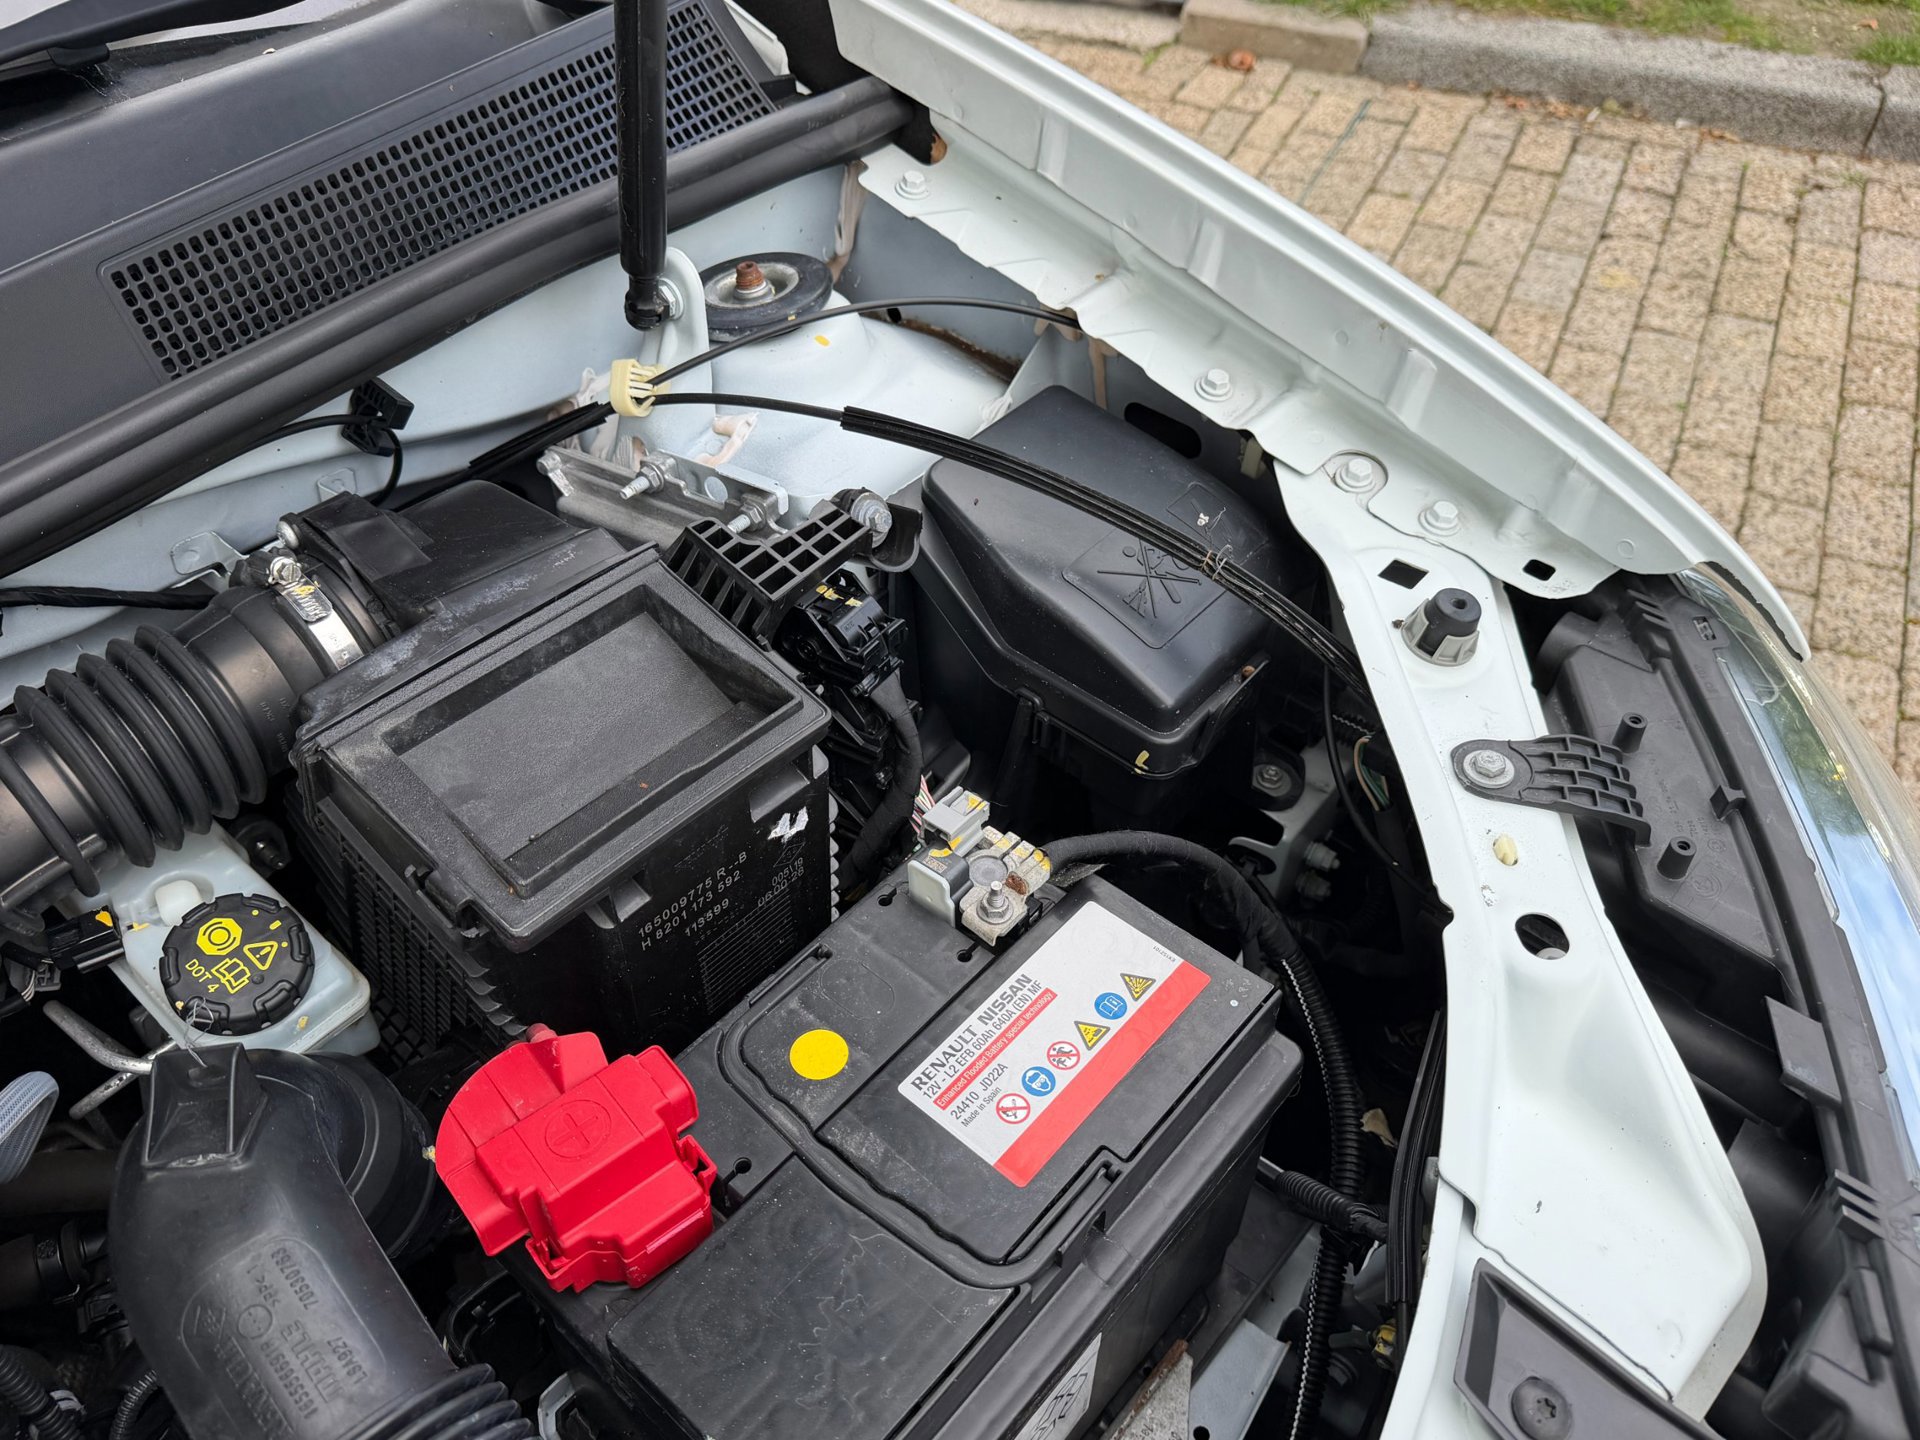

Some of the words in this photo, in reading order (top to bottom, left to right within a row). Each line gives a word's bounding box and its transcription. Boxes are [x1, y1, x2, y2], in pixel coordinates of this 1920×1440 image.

[638, 877, 713, 938] 165009775
[641, 937, 651, 951] H
[655, 912, 688, 940] 8201
[691, 891, 713, 915] 173
[717, 870, 741, 893] 592
[185, 959, 212, 983] DOT
[207, 983, 219, 992] 4
[910, 1025, 978, 1091] RENAULT
[977, 973, 1033, 1027] NISSAN
[922, 1080, 942, 1100] 12V
[948, 1064, 960, 1079] L2
[956, 1047, 975, 1067] EFB
[972, 1028, 997, 1054] 60Ah
[993, 1009, 1017, 1032] 640A
[1012, 994, 1034, 1013] (EN)
[1031, 980, 1044, 996] MF
[936, 1071, 968, 1107] Enhanced
[965, 1050, 989, 1076] Flooded
[986, 1031, 1008, 1056] Battery
[1005, 1018, 1026, 1039] special
[1023, 991, 1054, 1022] technology
[950, 1090, 980, 1121] 24410
[983, 1062, 1009, 1092] JD22A
[961, 1107, 981, 1128] Made
[978, 1100, 986, 1110] in
[983, 1086, 1003, 1106] Spain
